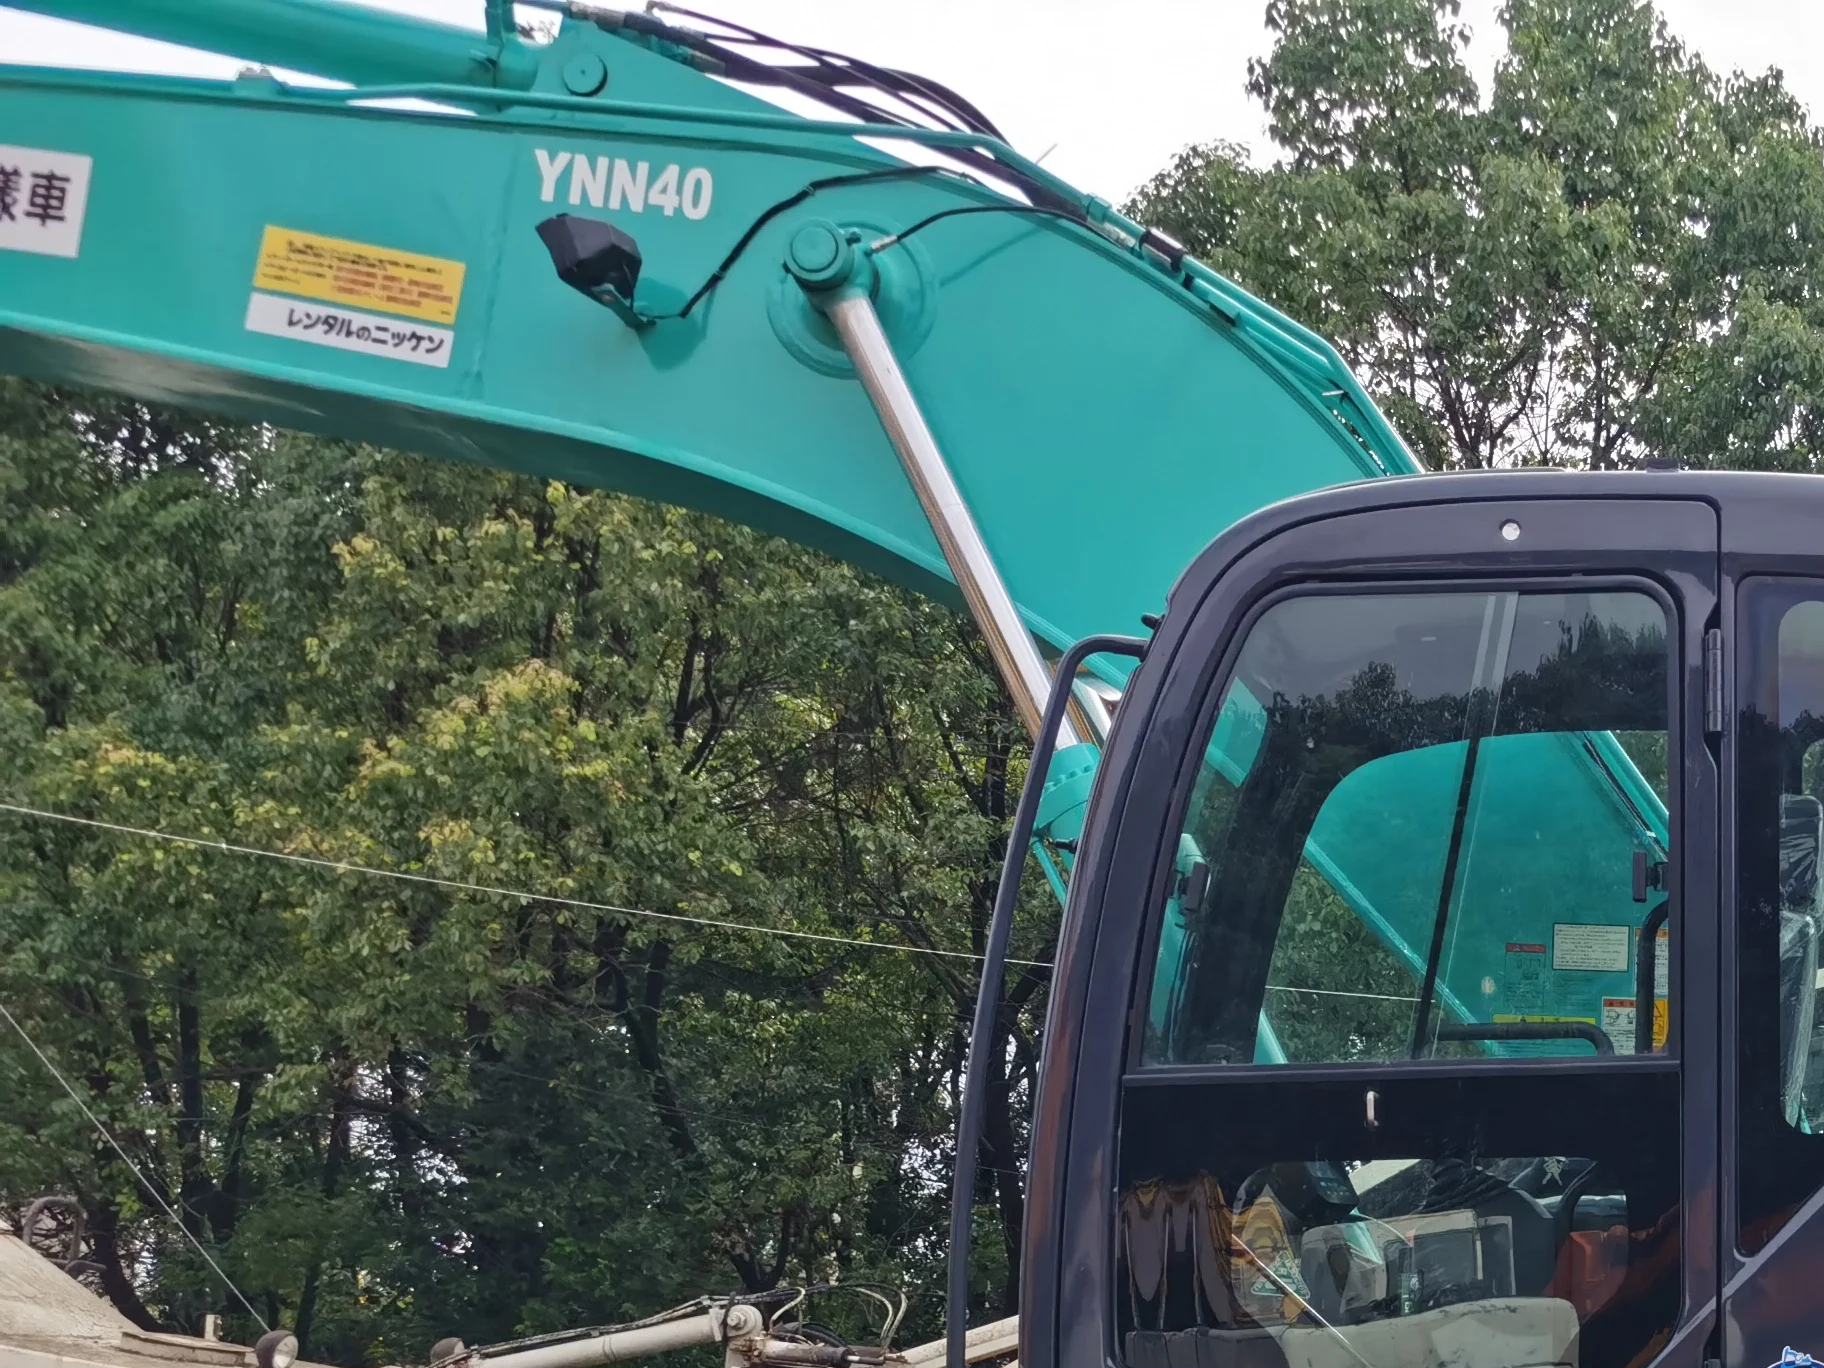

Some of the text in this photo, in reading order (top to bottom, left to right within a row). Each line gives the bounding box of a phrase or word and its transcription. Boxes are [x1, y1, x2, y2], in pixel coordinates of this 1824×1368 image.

[534, 149, 713, 220] YNN40
[288, 308, 444, 354] レンタルのニッケン
